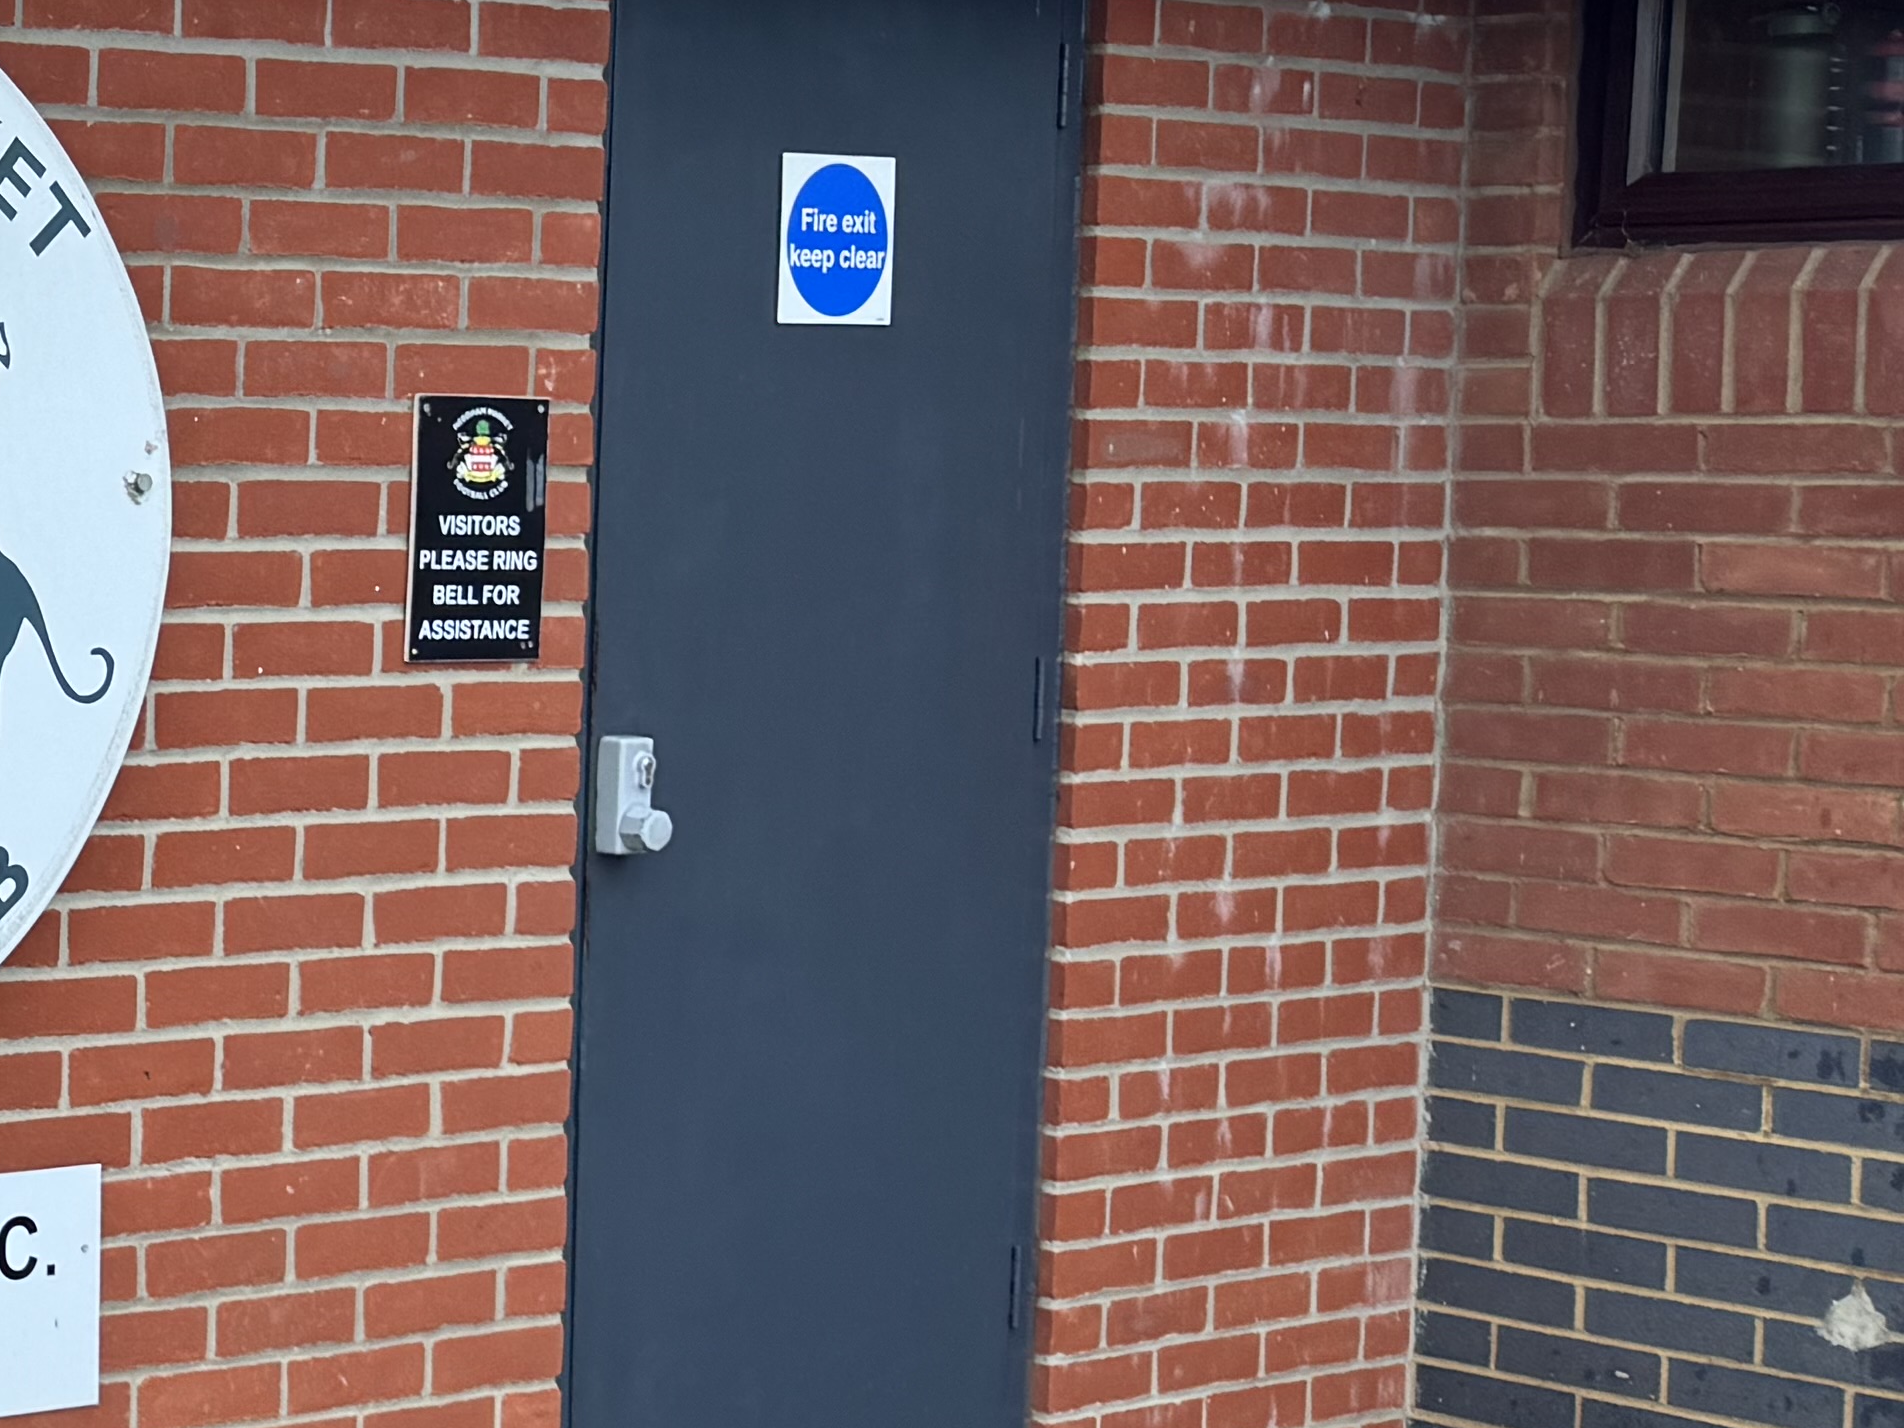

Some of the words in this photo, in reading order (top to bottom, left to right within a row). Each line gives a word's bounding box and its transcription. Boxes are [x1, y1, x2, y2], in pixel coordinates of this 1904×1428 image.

[801, 207, 838, 232] Fire
[842, 209, 877, 234] exit
[790, 243, 835, 274] keep
[839, 244, 885, 269] clear
[439, 514, 520, 536] VISITORS
[419, 549, 489, 571] PLEASE
[492, 549, 537, 571] RING
[432, 584, 478, 605] BELL
[482, 584, 520, 605] FOR
[418, 619, 529, 640] ASSISTANCE
